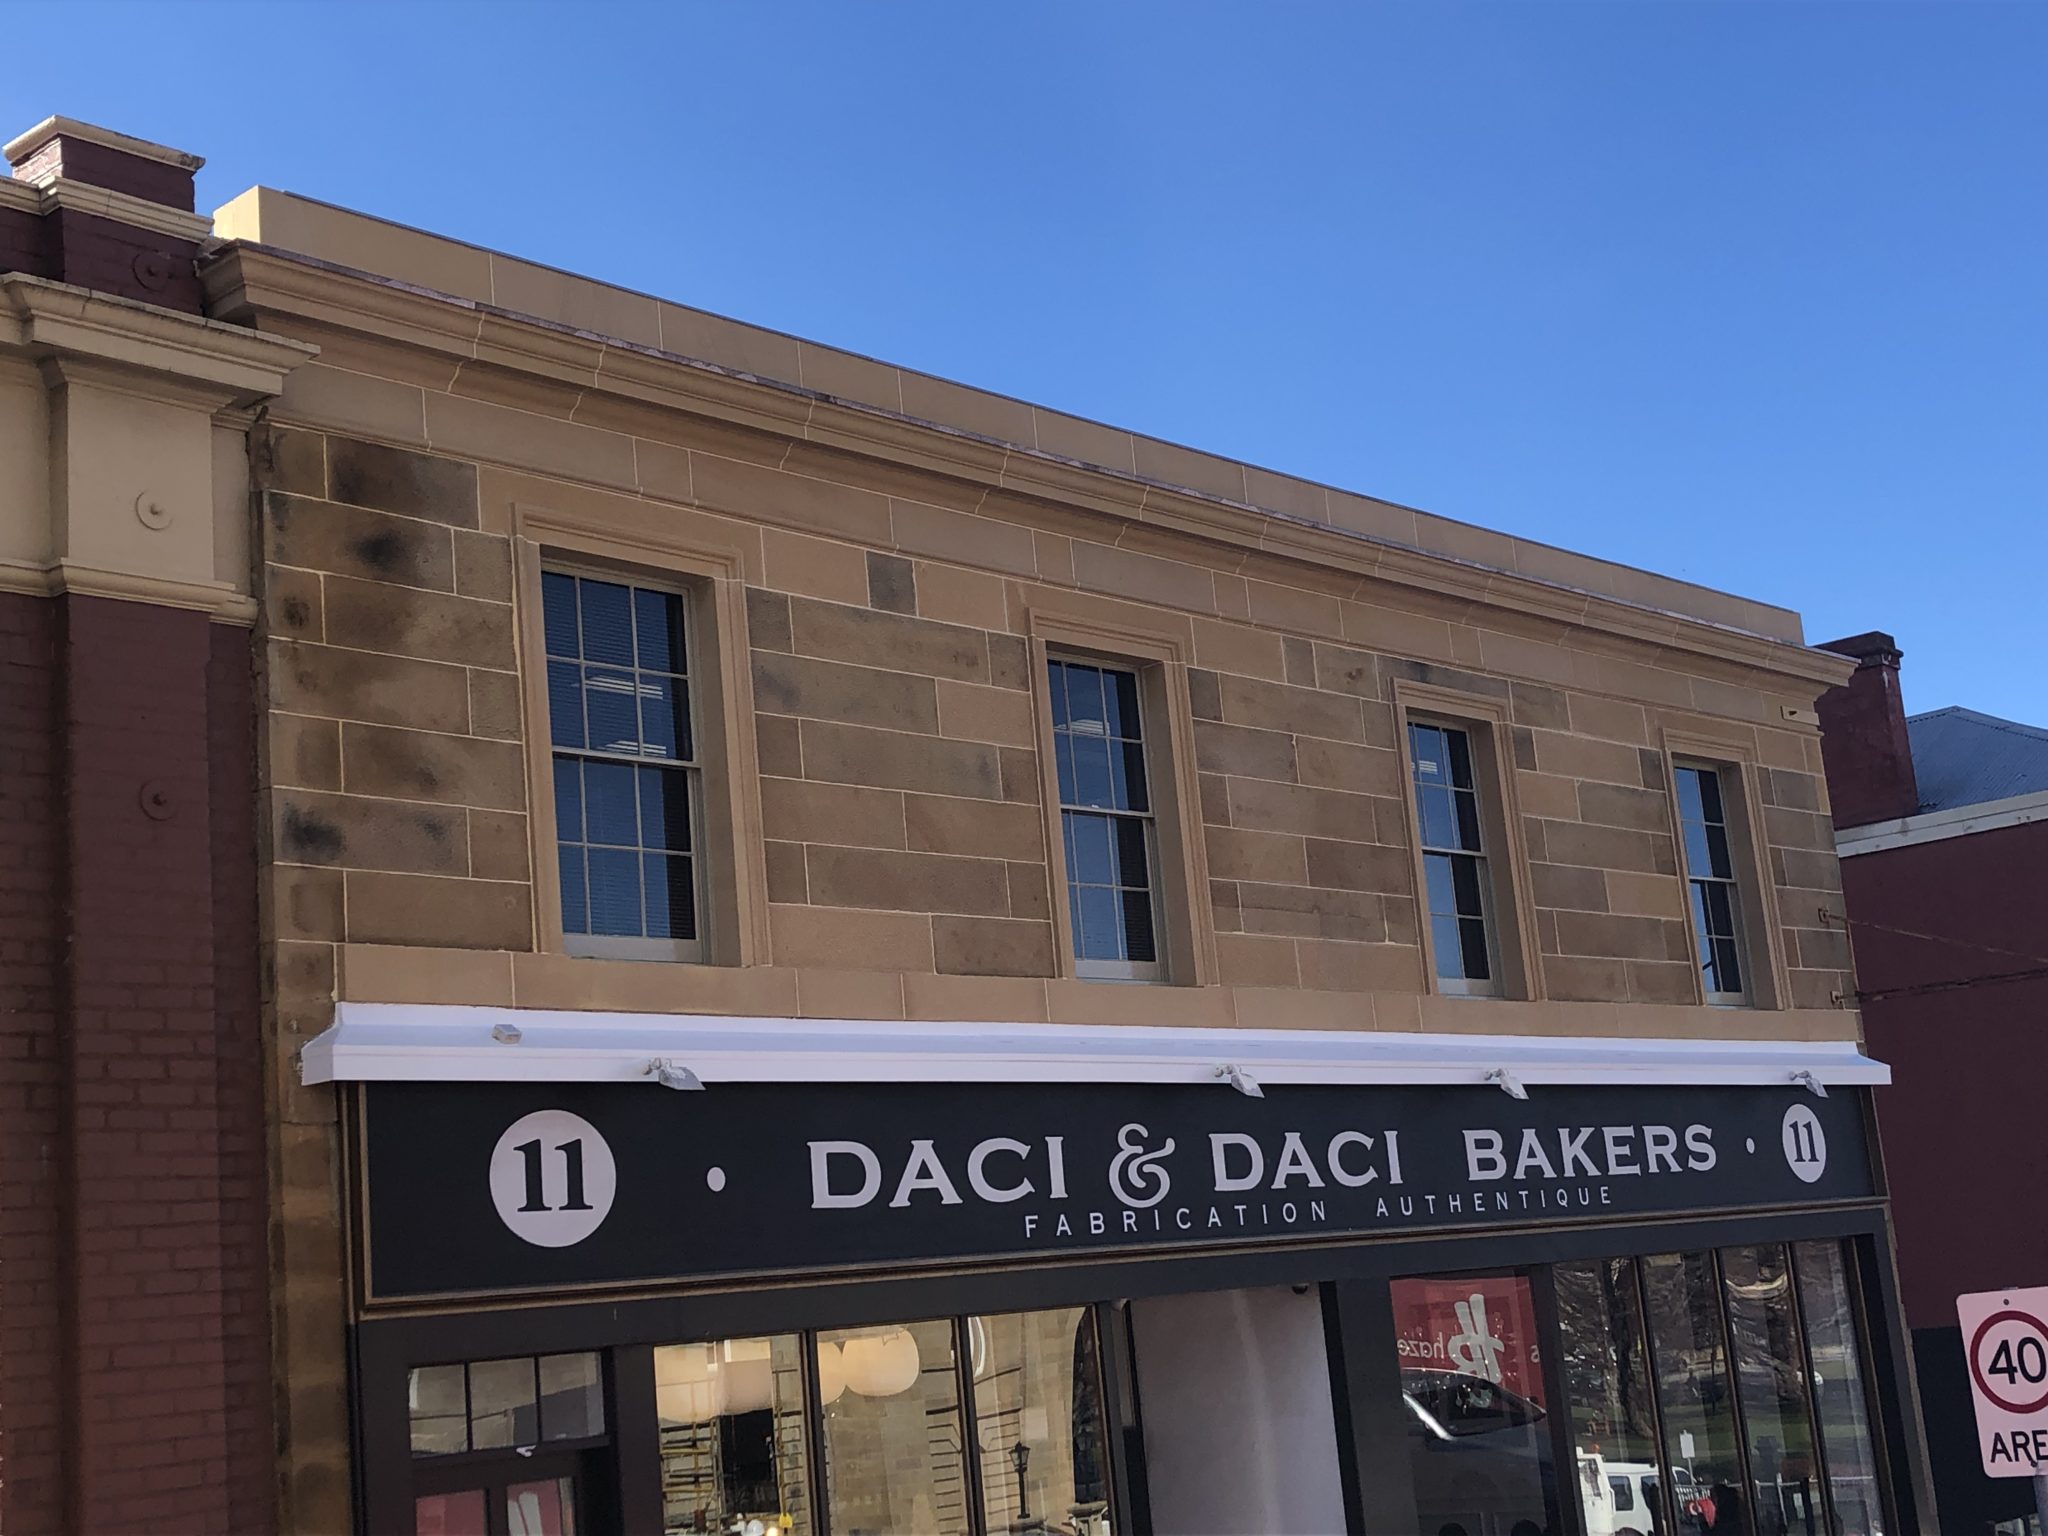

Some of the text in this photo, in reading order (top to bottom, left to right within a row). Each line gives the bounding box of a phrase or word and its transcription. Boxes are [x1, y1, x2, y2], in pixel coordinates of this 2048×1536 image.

[807, 1123, 1717, 1209] DACI & DACI BAKERS
[1788, 1120, 1820, 1163] 11
[512, 1138, 594, 1212] 11
[1024, 1185, 1612, 1239] FABRICATION AUTHENTIQUE
[1987, 1336, 2047, 1385] 40
